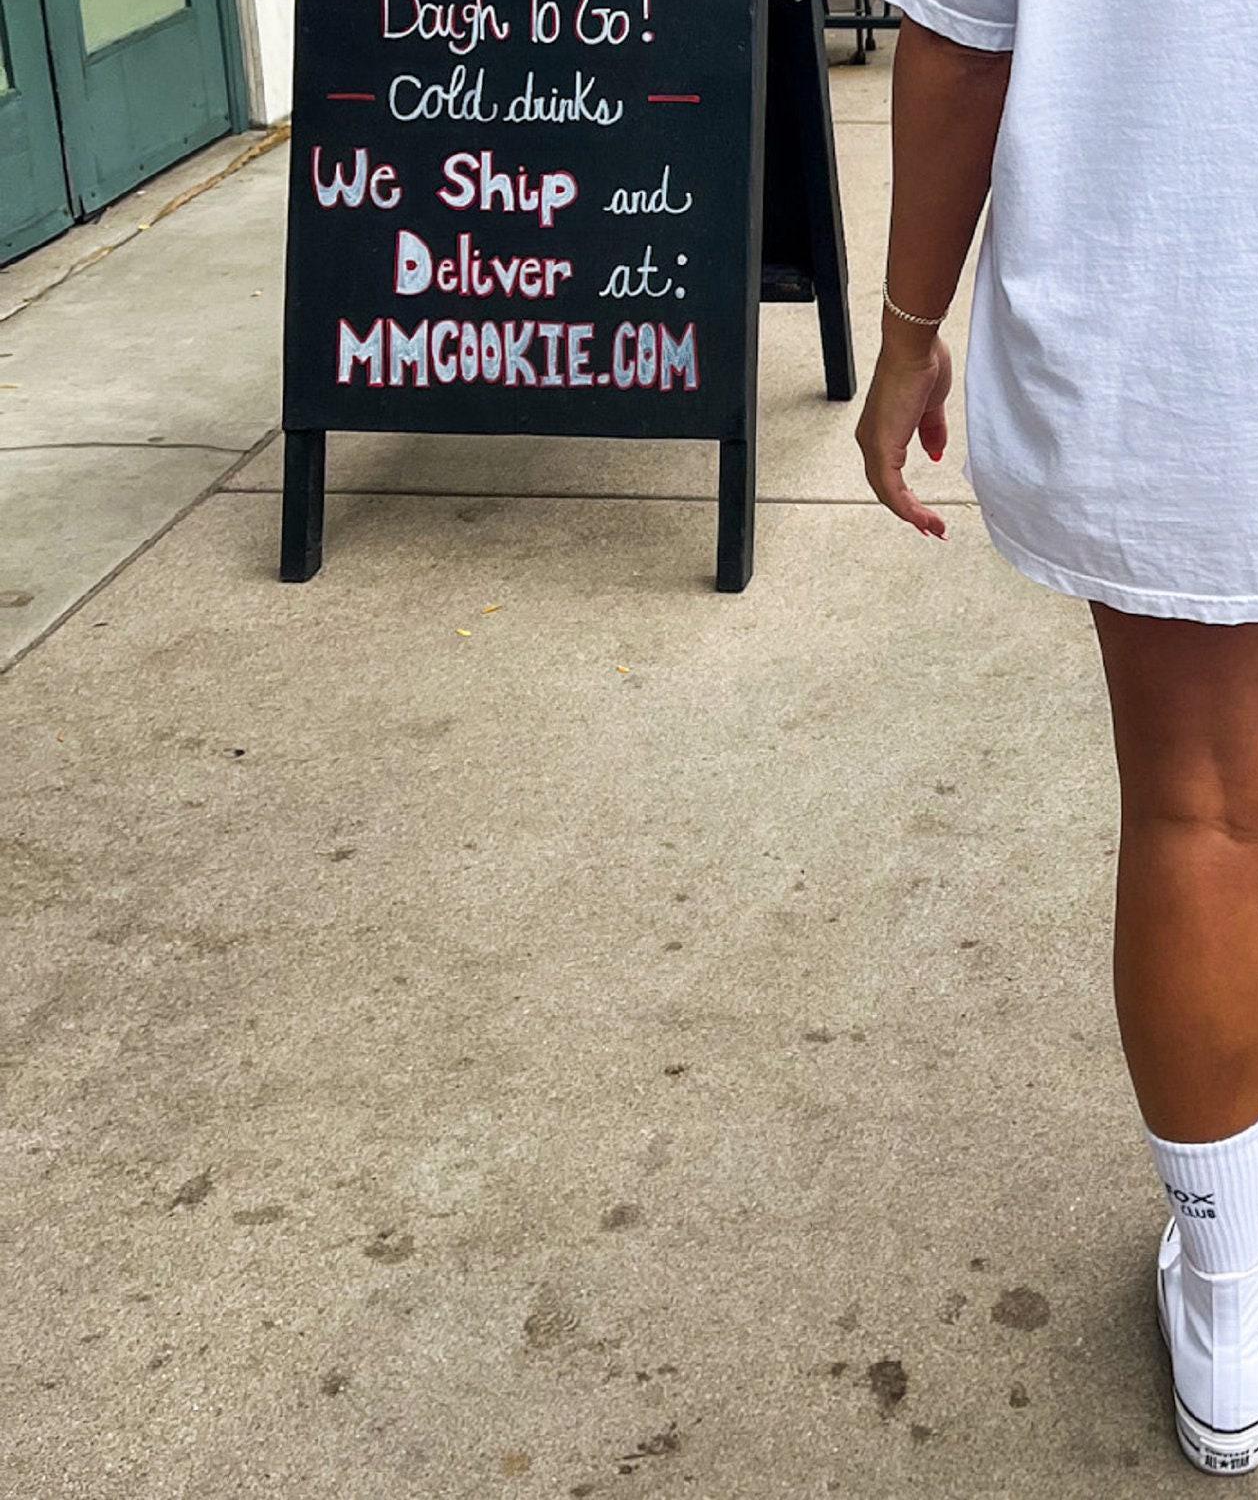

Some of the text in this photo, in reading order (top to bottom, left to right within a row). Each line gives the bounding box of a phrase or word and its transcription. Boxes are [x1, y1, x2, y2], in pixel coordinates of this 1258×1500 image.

[389, 64, 499, 122] Cold
[312, 145, 693, 229] We Ship and
[394, 228, 690, 299] Deliver at:
[336, 318, 700, 392] MMCOOKIE.COM
[1181, 1205, 1216, 1219] CLUB
